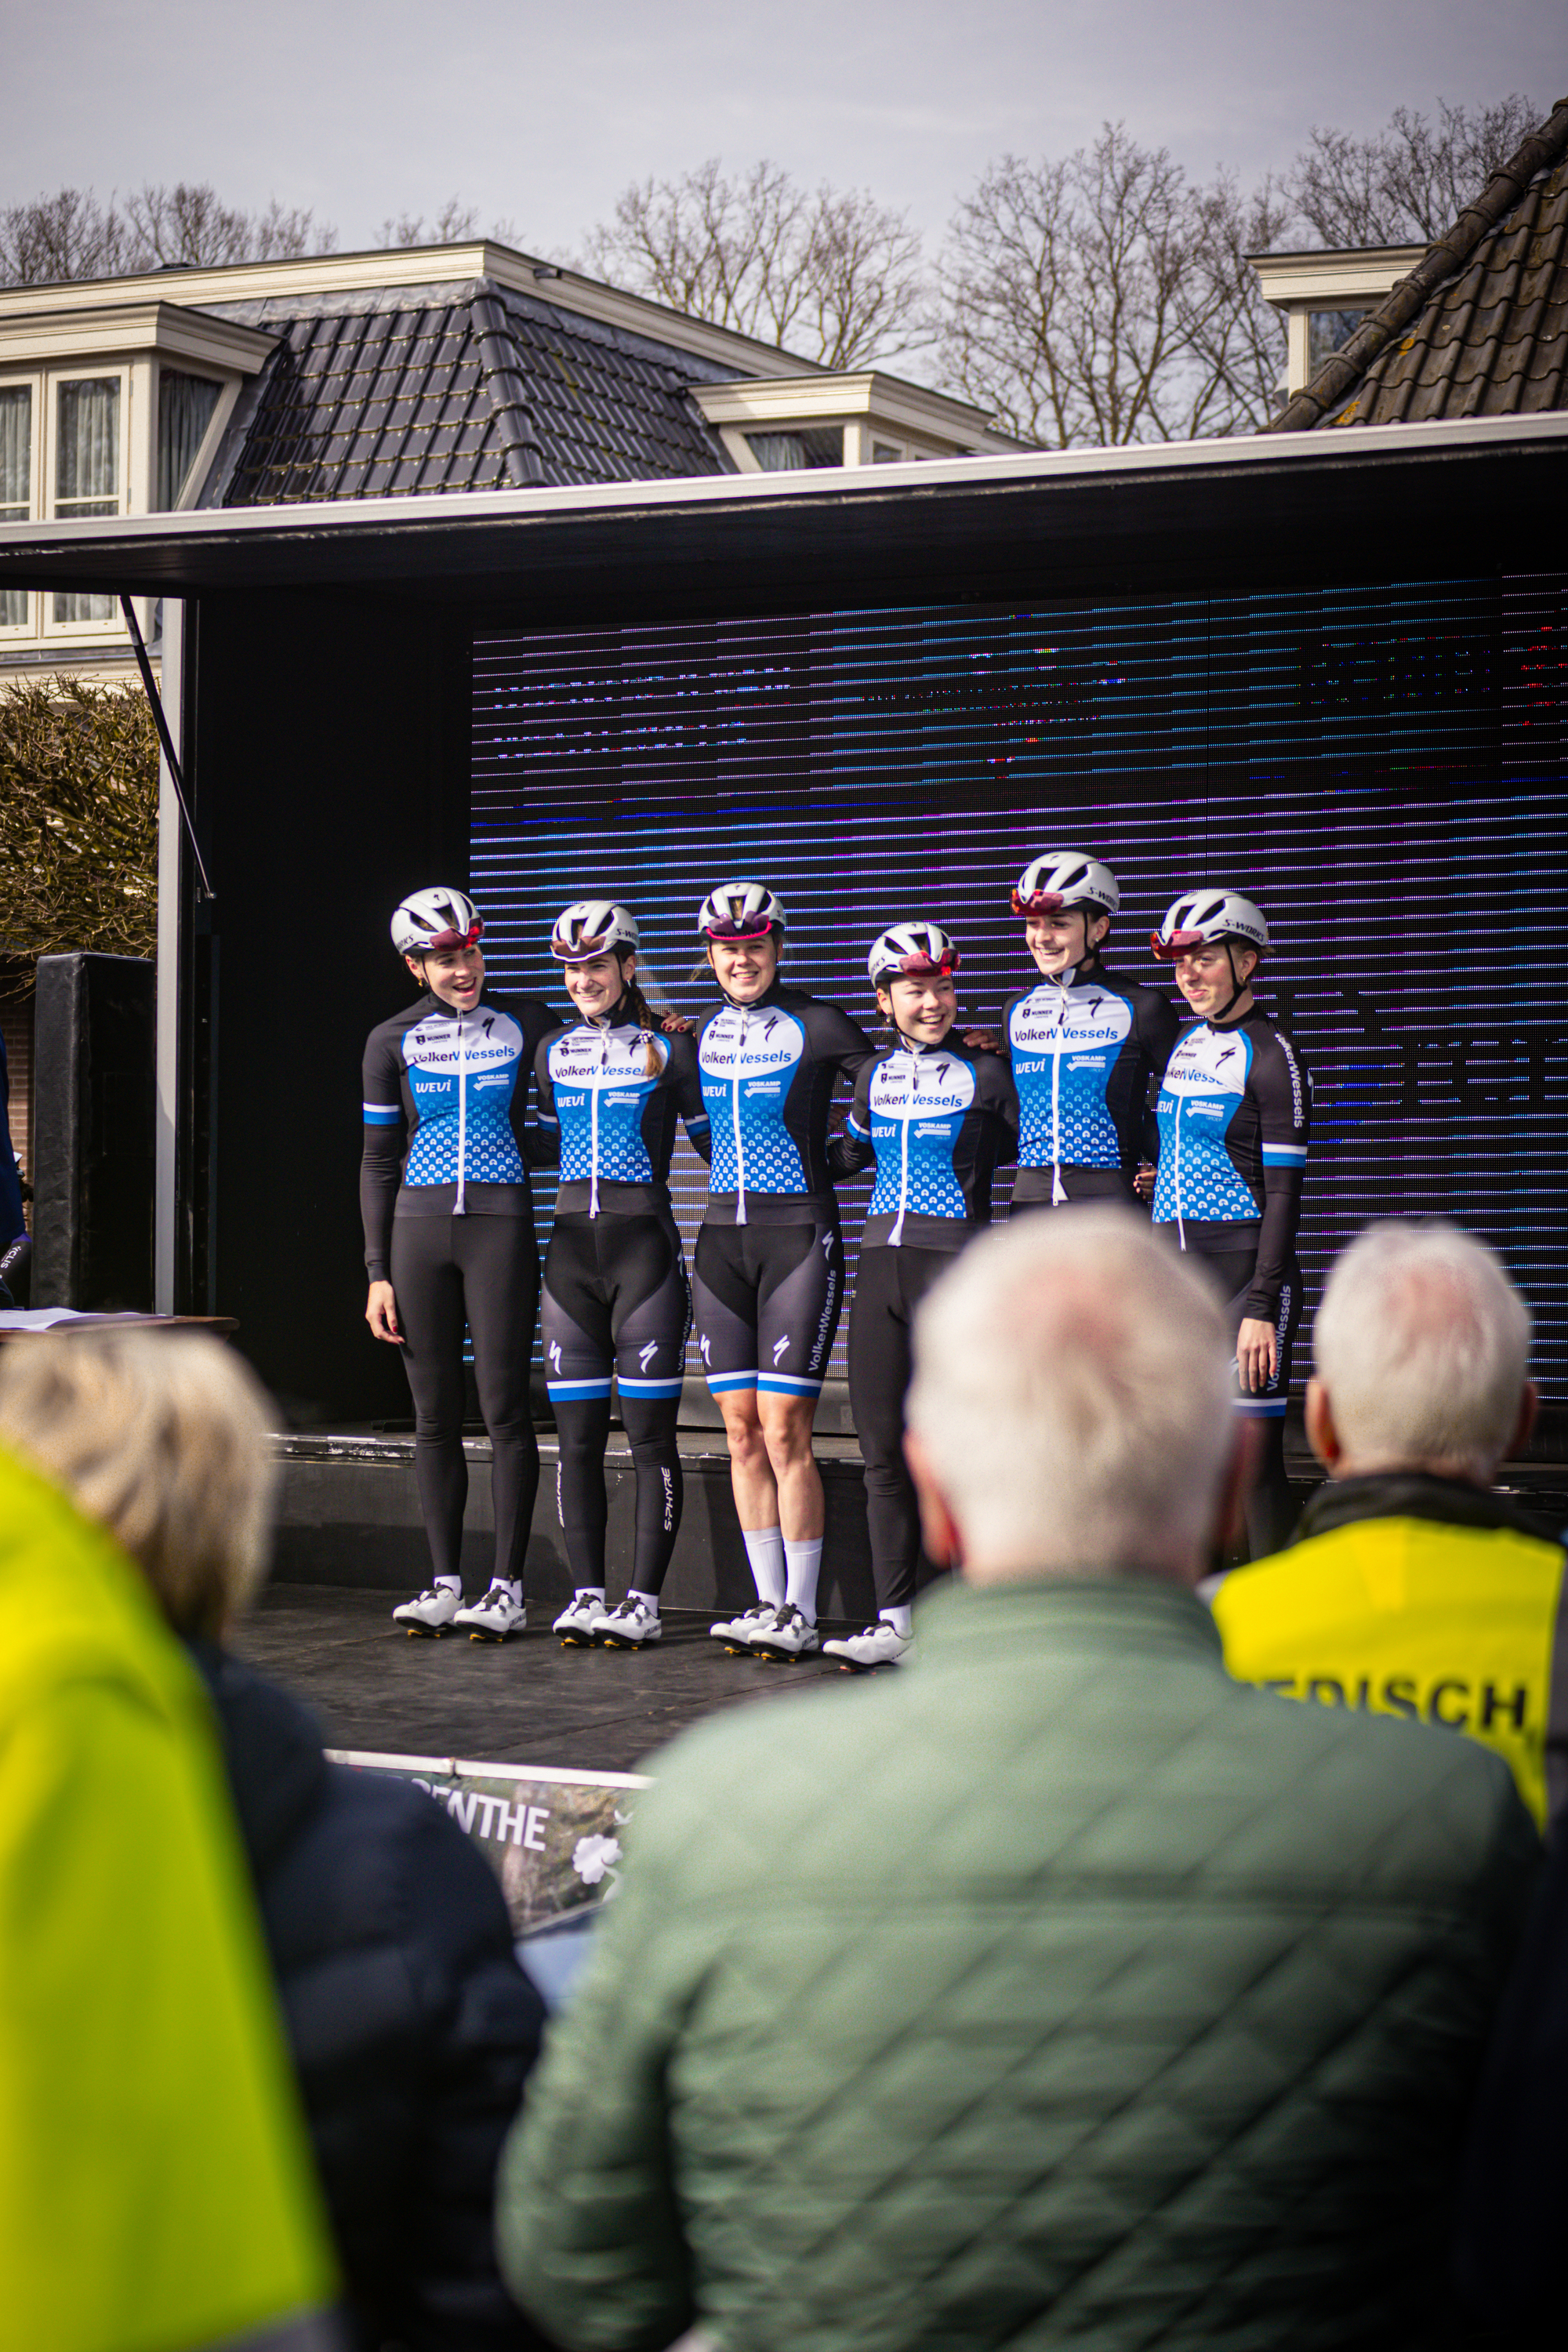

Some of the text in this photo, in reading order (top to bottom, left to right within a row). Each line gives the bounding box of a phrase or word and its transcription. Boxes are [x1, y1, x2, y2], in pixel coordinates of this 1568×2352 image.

[1222, 918, 1265, 942] S-WORKS
[1014, 1027, 1119, 1042] VolkerWessels
[701, 1050, 792, 1064] VolkerWessels
[555, 1065, 646, 1078] VolkerWessel
[873, 1093, 964, 1107] VolkerWessels
[1191, 1099, 1225, 1111] VOSKAMP
[808, 1269, 837, 1372] VolkerWessels
[660, 1466, 673, 1532] S-PHYRE
